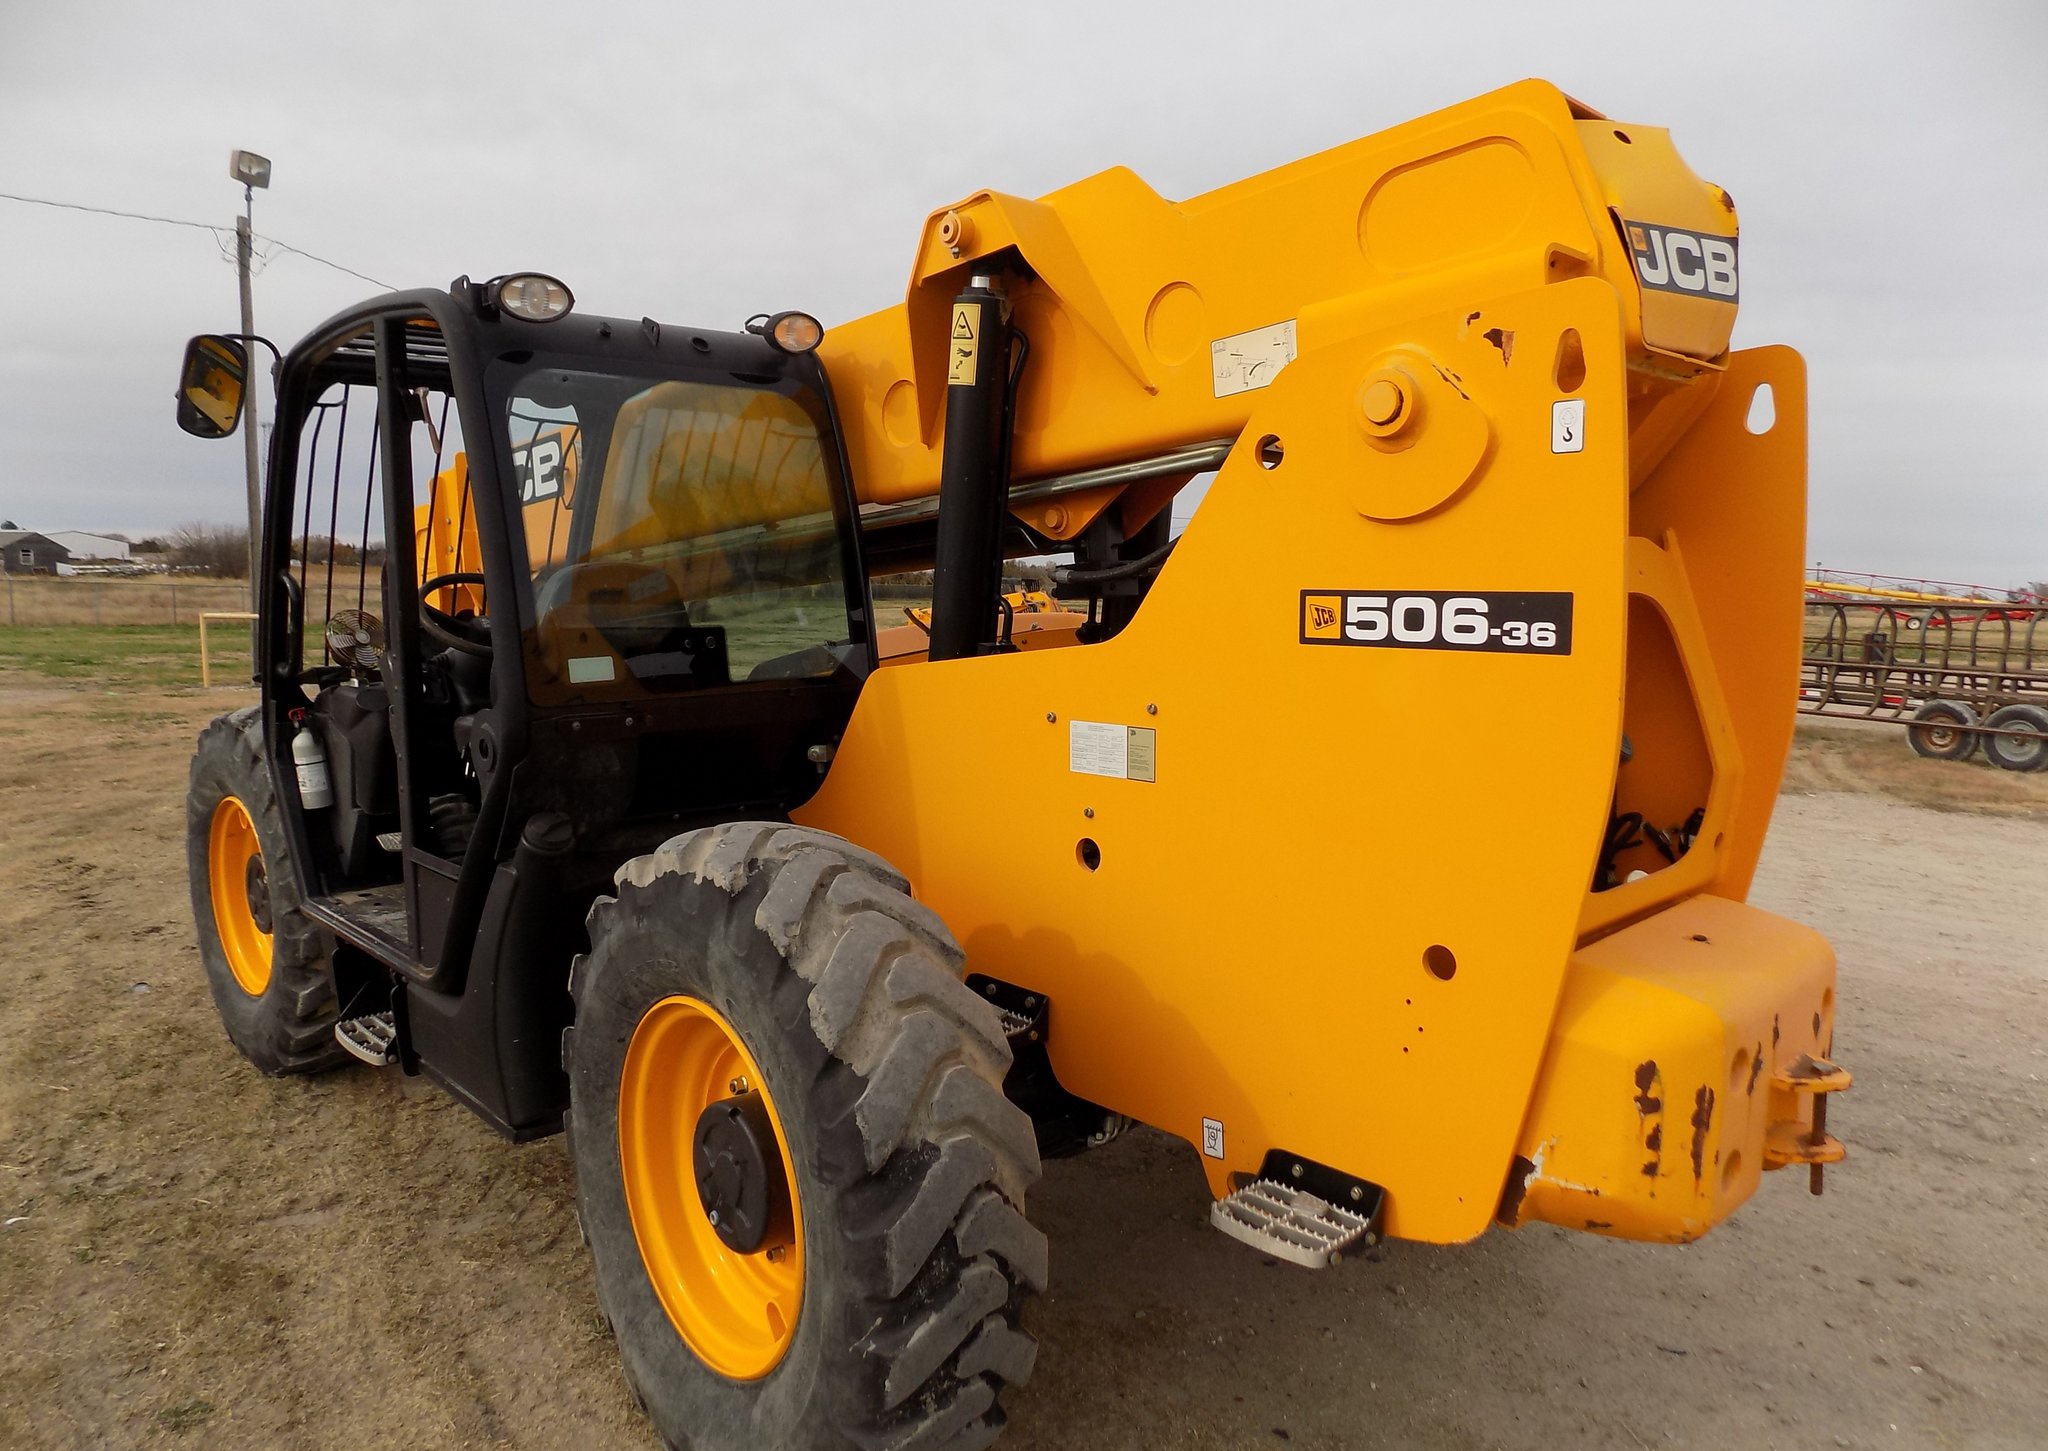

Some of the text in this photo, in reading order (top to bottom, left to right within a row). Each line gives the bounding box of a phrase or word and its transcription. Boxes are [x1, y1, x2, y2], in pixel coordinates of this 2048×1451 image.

[1636, 229, 1738, 297] JCB
[512, 441, 560, 502] CB
[1314, 596, 1557, 648] JCB 506-36
